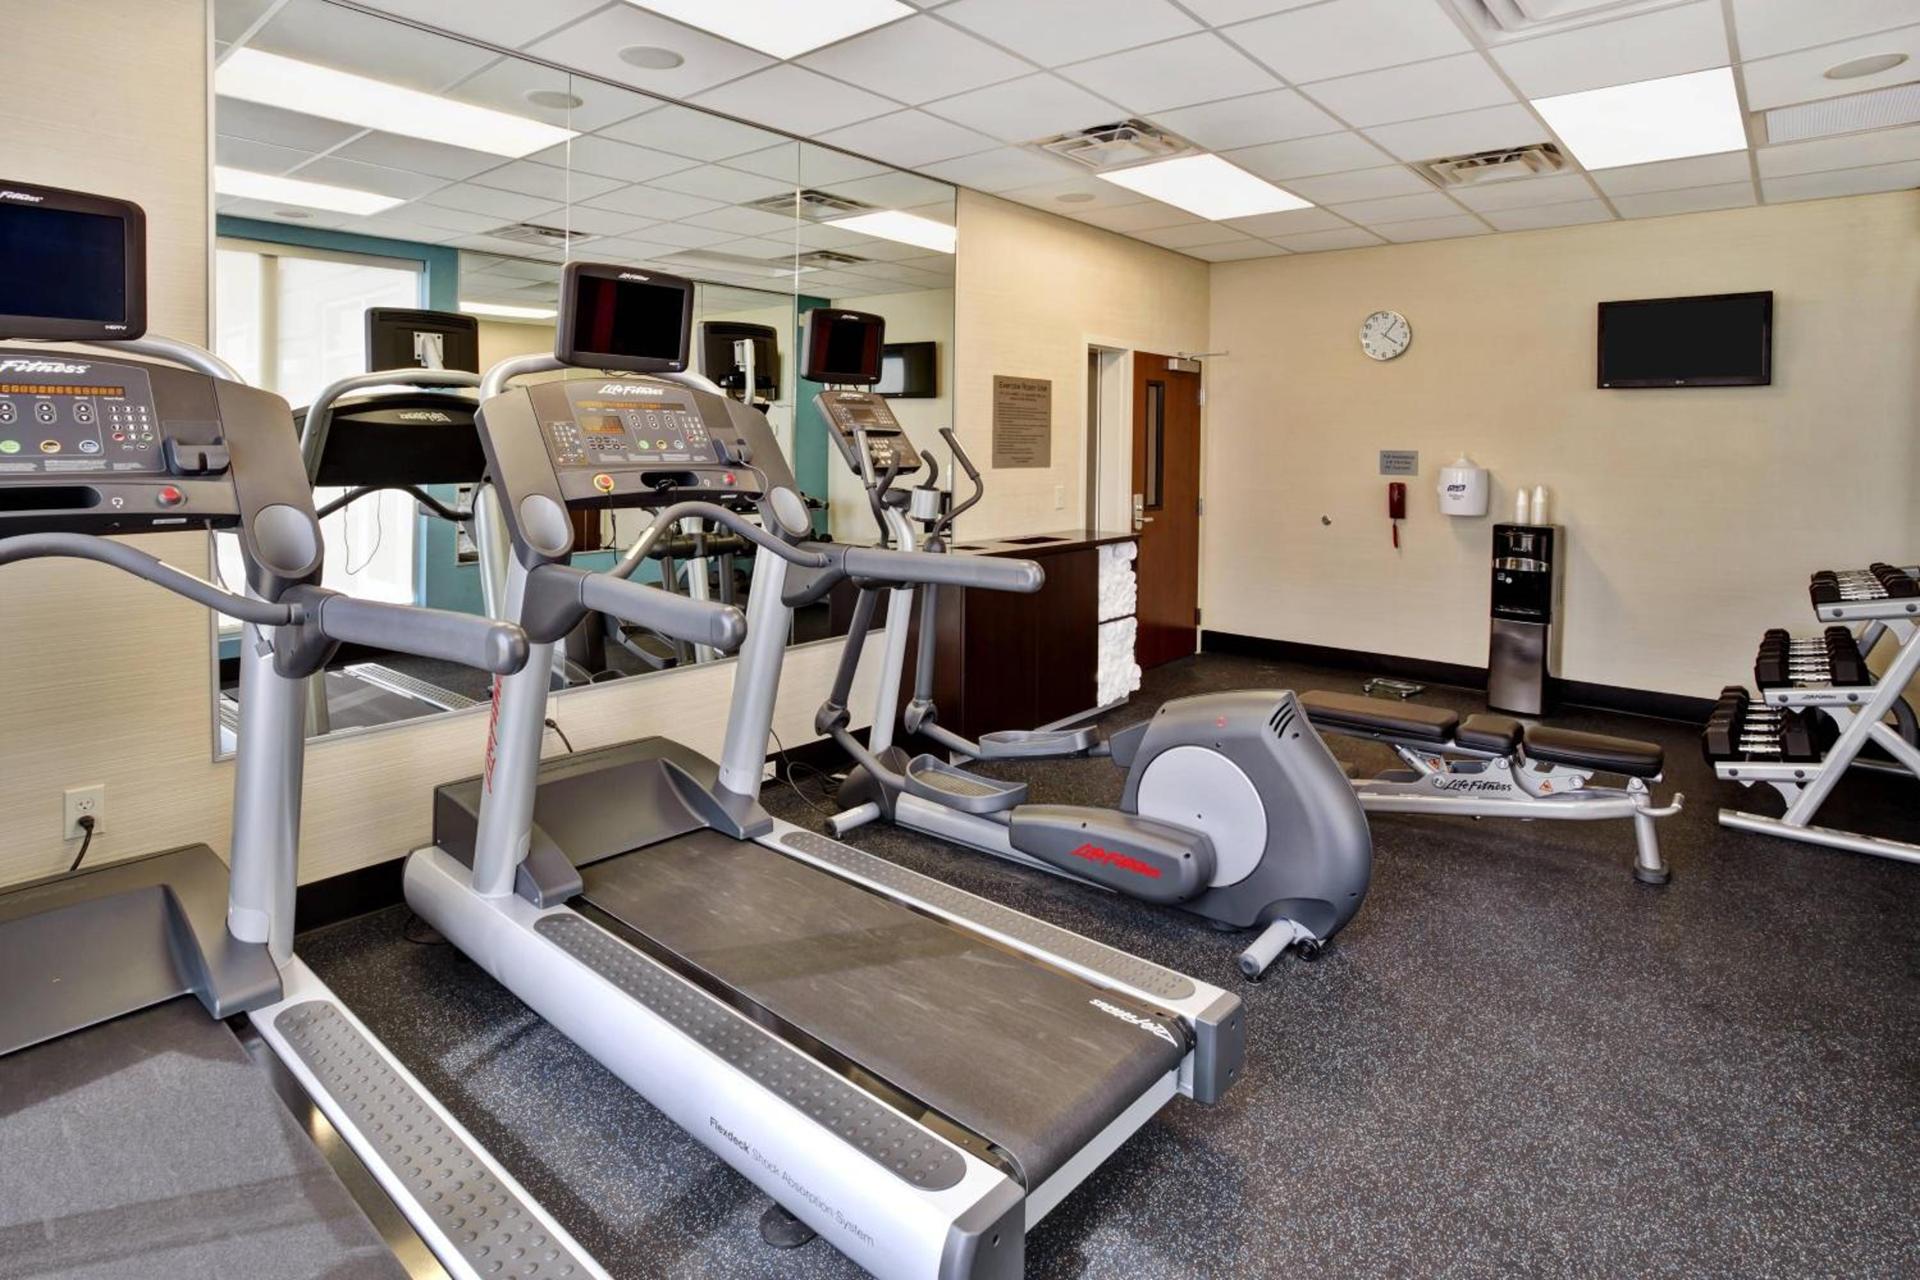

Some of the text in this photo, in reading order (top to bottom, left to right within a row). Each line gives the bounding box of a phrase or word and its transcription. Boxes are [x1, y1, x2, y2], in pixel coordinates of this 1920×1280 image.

[709, 1116, 750, 1154] Flexdeck
[752, 1147, 779, 1175] Shock
[836, 1210, 875, 1248] System
